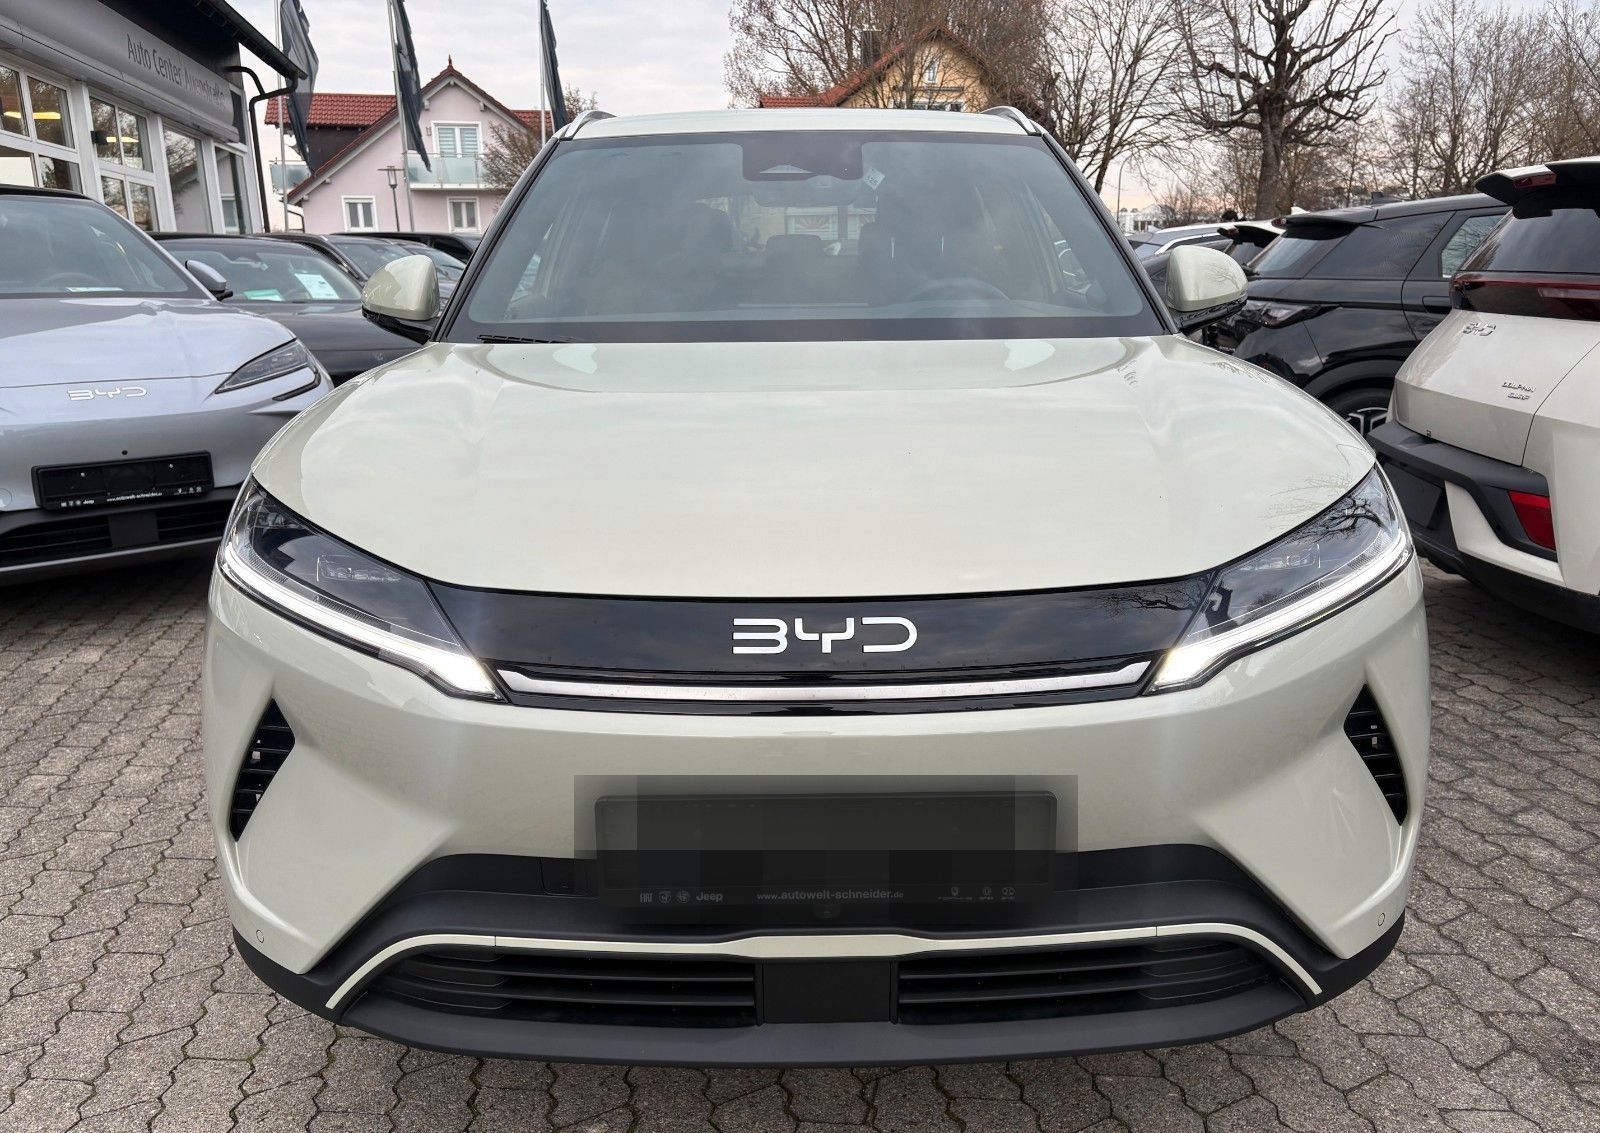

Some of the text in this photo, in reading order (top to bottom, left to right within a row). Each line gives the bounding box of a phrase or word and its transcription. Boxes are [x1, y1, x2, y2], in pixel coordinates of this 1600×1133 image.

[126, 33, 152, 70] Auto
[152, 48, 182, 86] Center
[67, 386, 147, 401] BYD
[732, 616, 918, 654] BYD
[639, 892, 653, 903] FIAT
[696, 891, 724, 903] Jeep
[756, 889, 904, 900] www.autowelt-schneider.de
